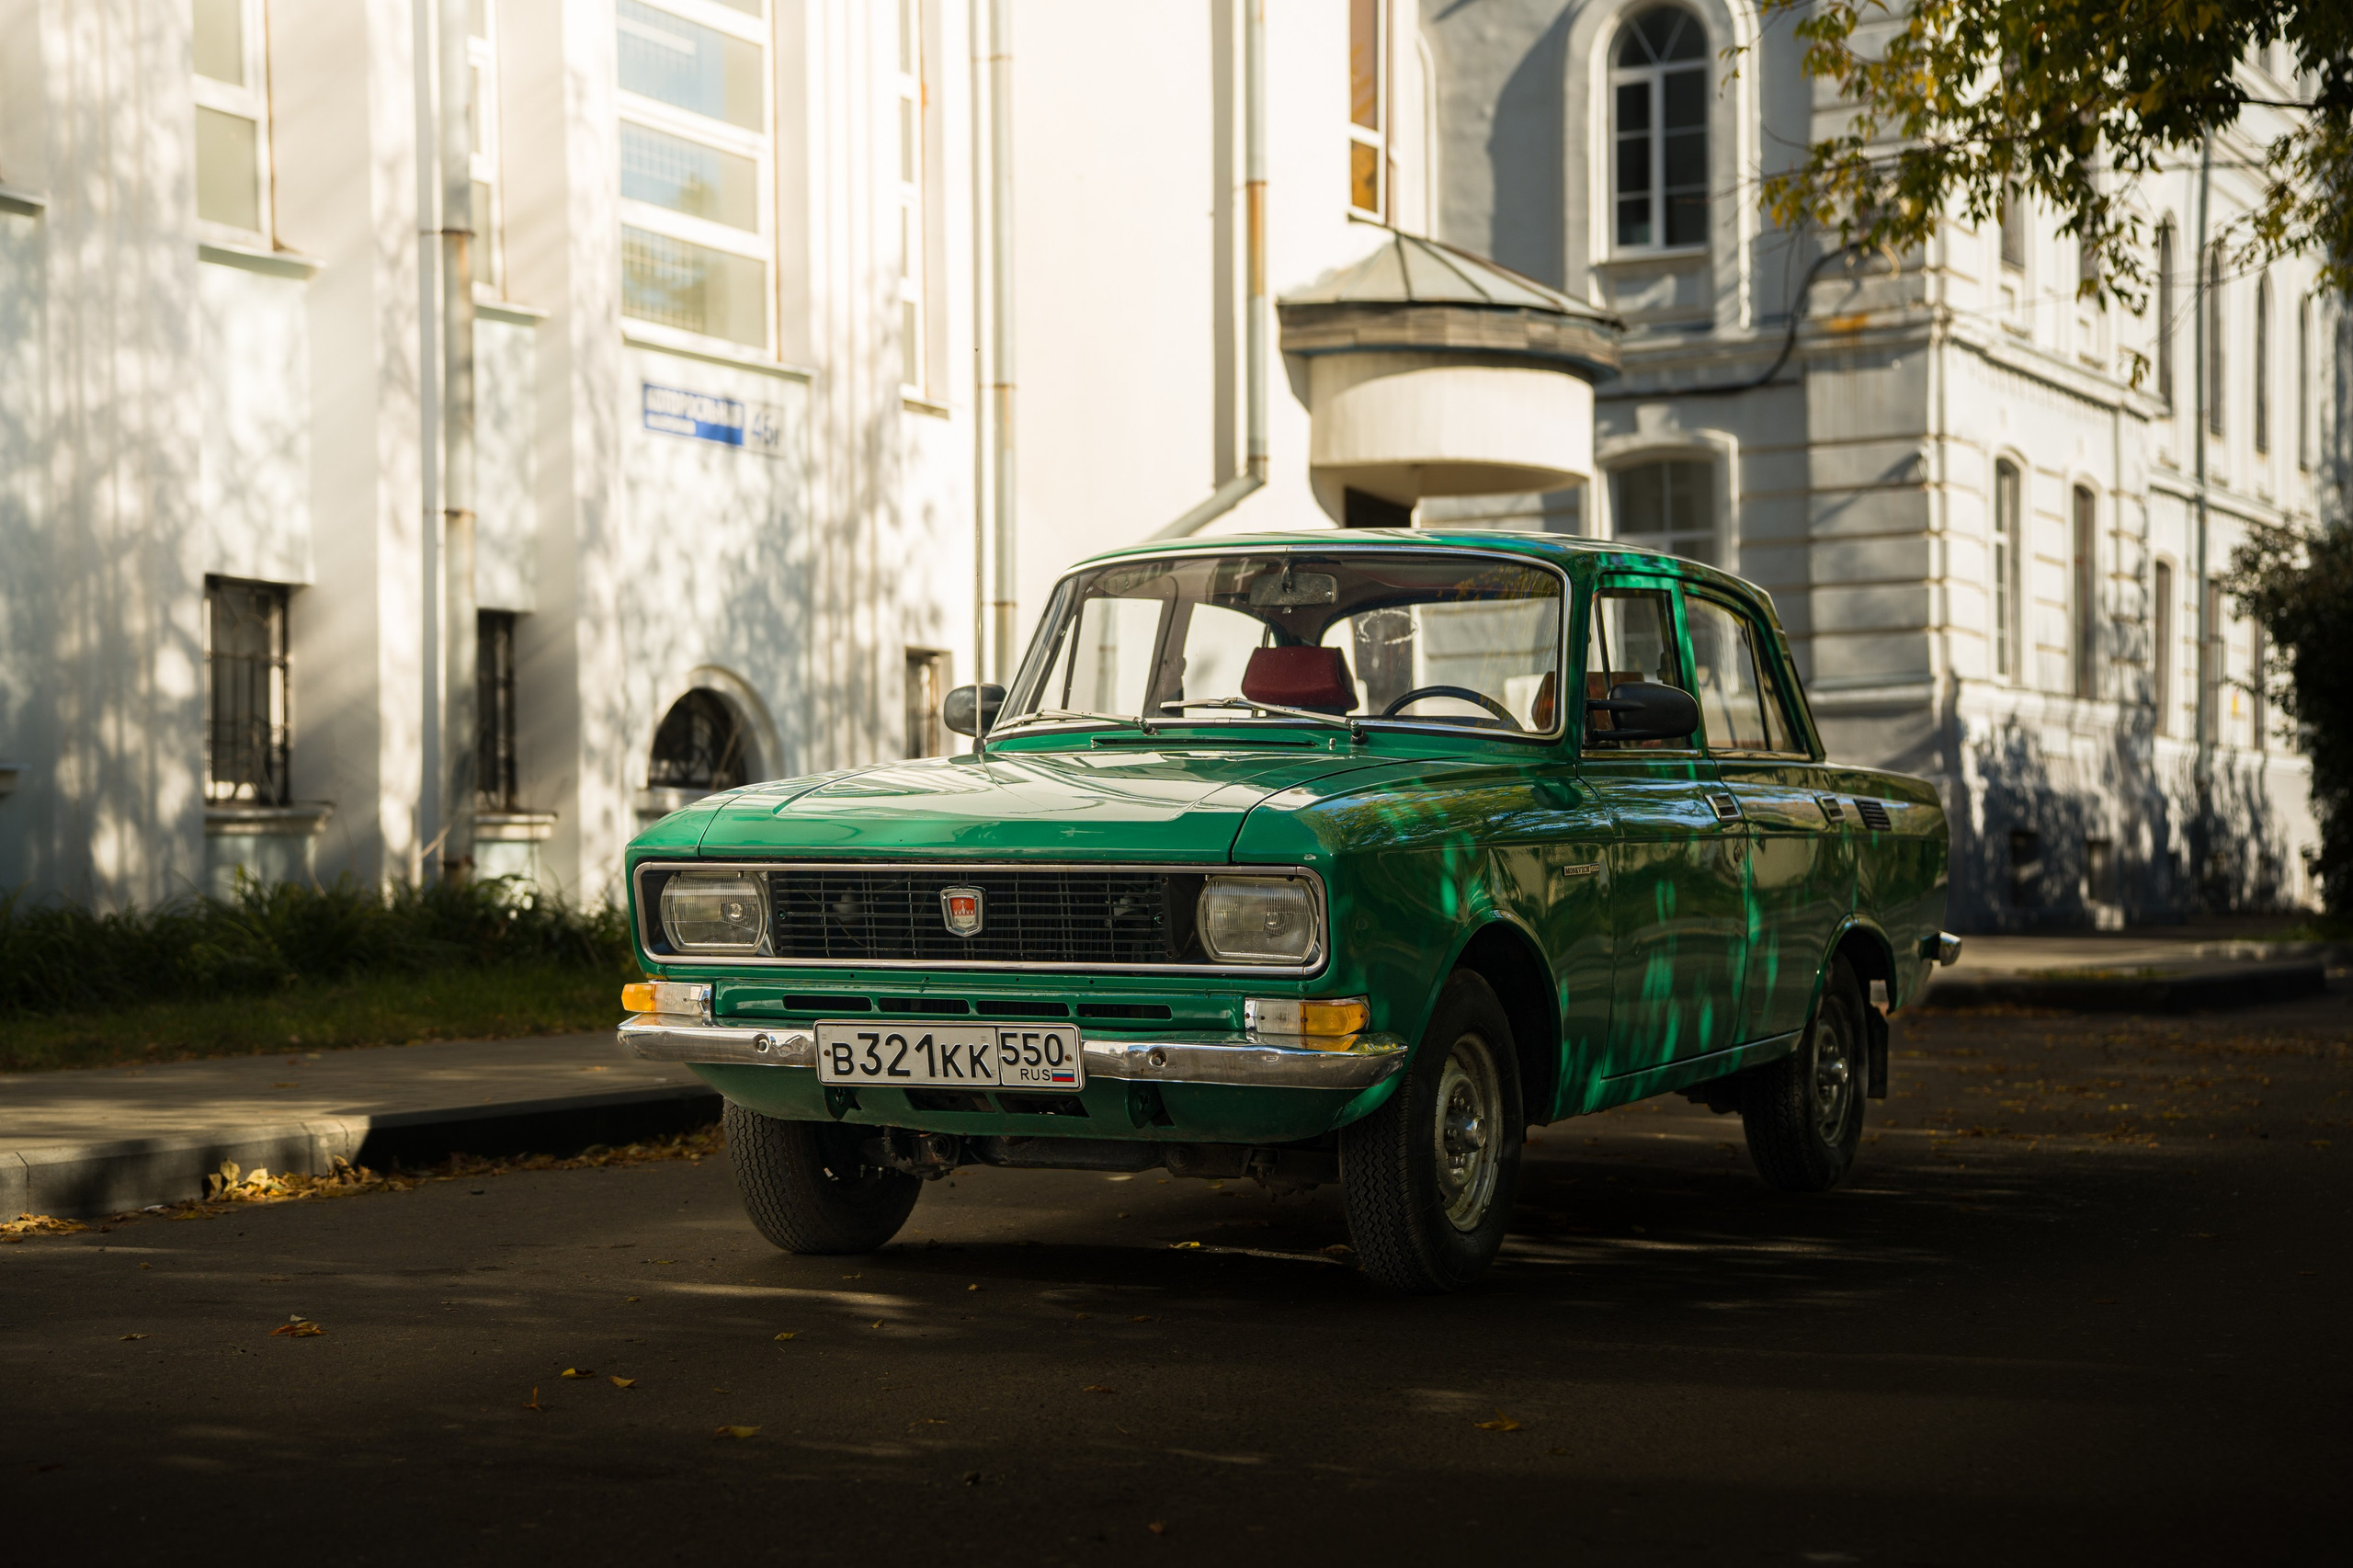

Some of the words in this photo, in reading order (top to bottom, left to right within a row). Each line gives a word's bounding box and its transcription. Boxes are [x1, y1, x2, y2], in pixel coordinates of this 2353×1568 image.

[1565, 866, 1590, 875] MOSKVICH
[1000, 1032, 1063, 1066] 550
[1020, 1068, 1051, 1081] RUS
